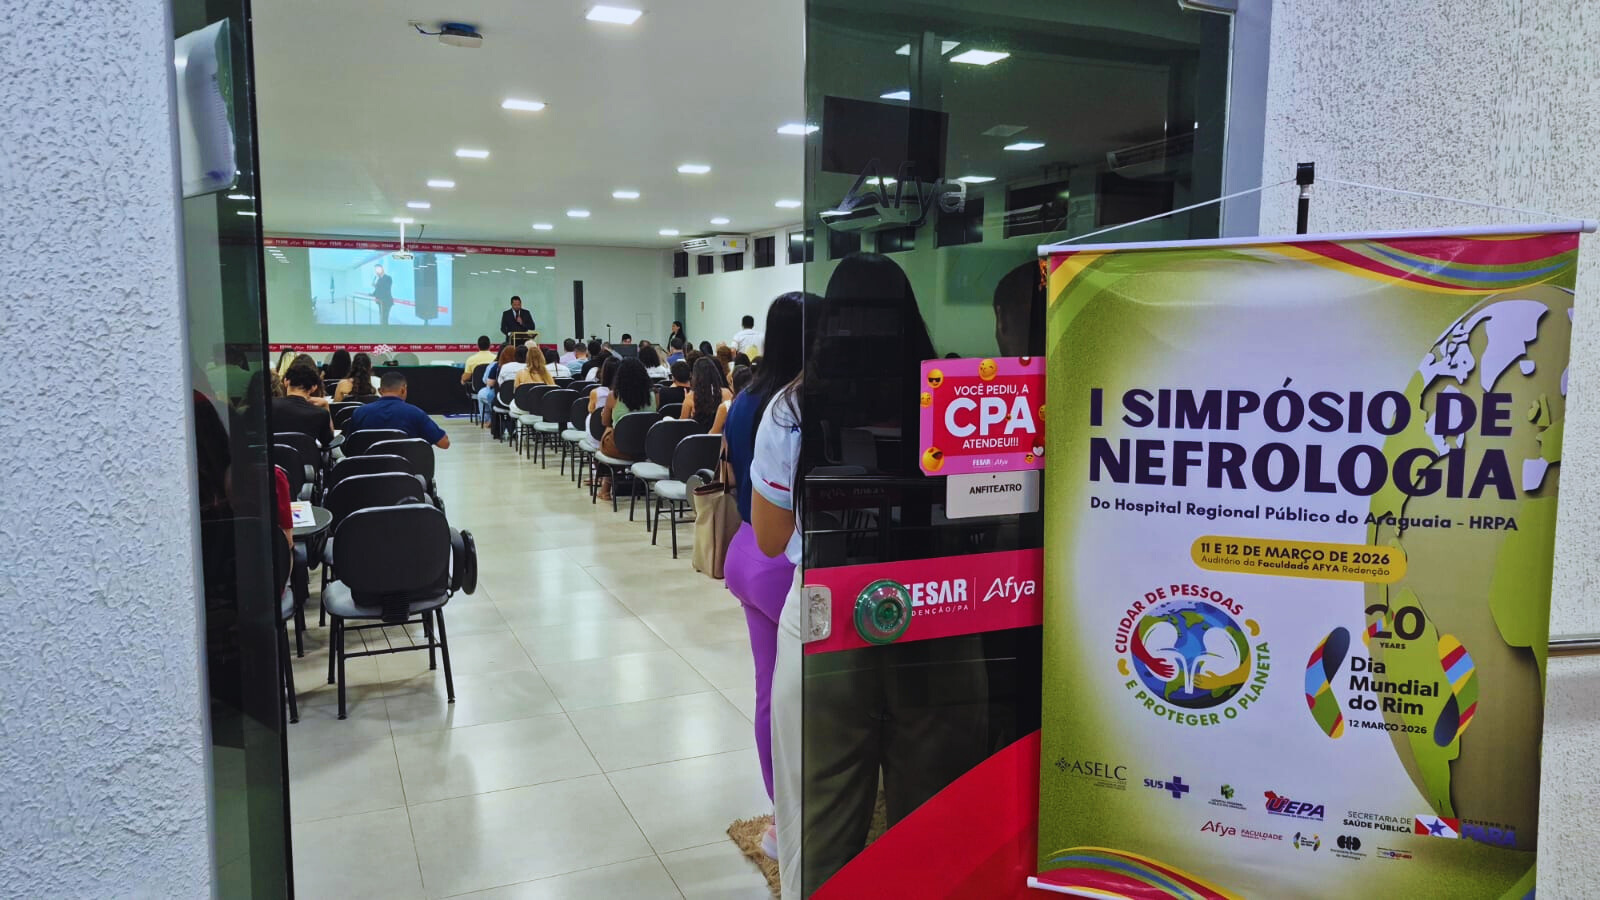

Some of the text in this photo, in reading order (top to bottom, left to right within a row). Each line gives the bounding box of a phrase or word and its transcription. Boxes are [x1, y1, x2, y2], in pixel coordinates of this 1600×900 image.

[954, 384, 1029, 396] VOCÊ PEDIU, A
[945, 396, 1036, 437] CPA
[1090, 377, 1513, 436] I SIMPÓSIO DE
[963, 437, 1019, 449] ATENDEU!!!
[1089, 437, 1517, 500] NEFROLOGIA
[969, 483, 1022, 495] ANFITEATRO
[1090, 496, 1110, 509] Do
[1115, 498, 1181, 516] Hospital
[1186, 502, 1260, 520] Regional
[1265, 506, 1330, 522] Público
[1335, 509, 1359, 525] do
[1363, 511, 1451, 531] Araguaia
[1469, 516, 1519, 531] HRPA
[1201, 542, 1390, 565] 11 E 12 DE MARÇO DE 2026
[1201, 555, 1390, 577] Auditório da Faculdade AFYA Redenção
[906, 576, 1036, 607] ESAR Afya
[1115, 584, 1244, 653] CUIDAR DE PESSOAS
[1364, 604, 1426, 640] 20
[1380, 642, 1406, 650] YEARS
[1350, 656, 1386, 674] Dia
[1125, 642, 1270, 726] E PROTEGER O PLANETA
[1349, 675, 1439, 697] Mundial
[1348, 694, 1424, 715] do Rim
[1349, 719, 1428, 734] 12 MARÇO 2026
[1071, 760, 1128, 781] ASELC
[1143, 778, 1164, 789] SUS
[1267, 797, 1325, 818] UEPA
[1347, 811, 1412, 825] SECRETARIA DE
[1200, 820, 1237, 837] Afya
[1241, 829, 1284, 841] FACULDADE
[1343, 818, 1412, 834] SAÚDE PÚBLICA
